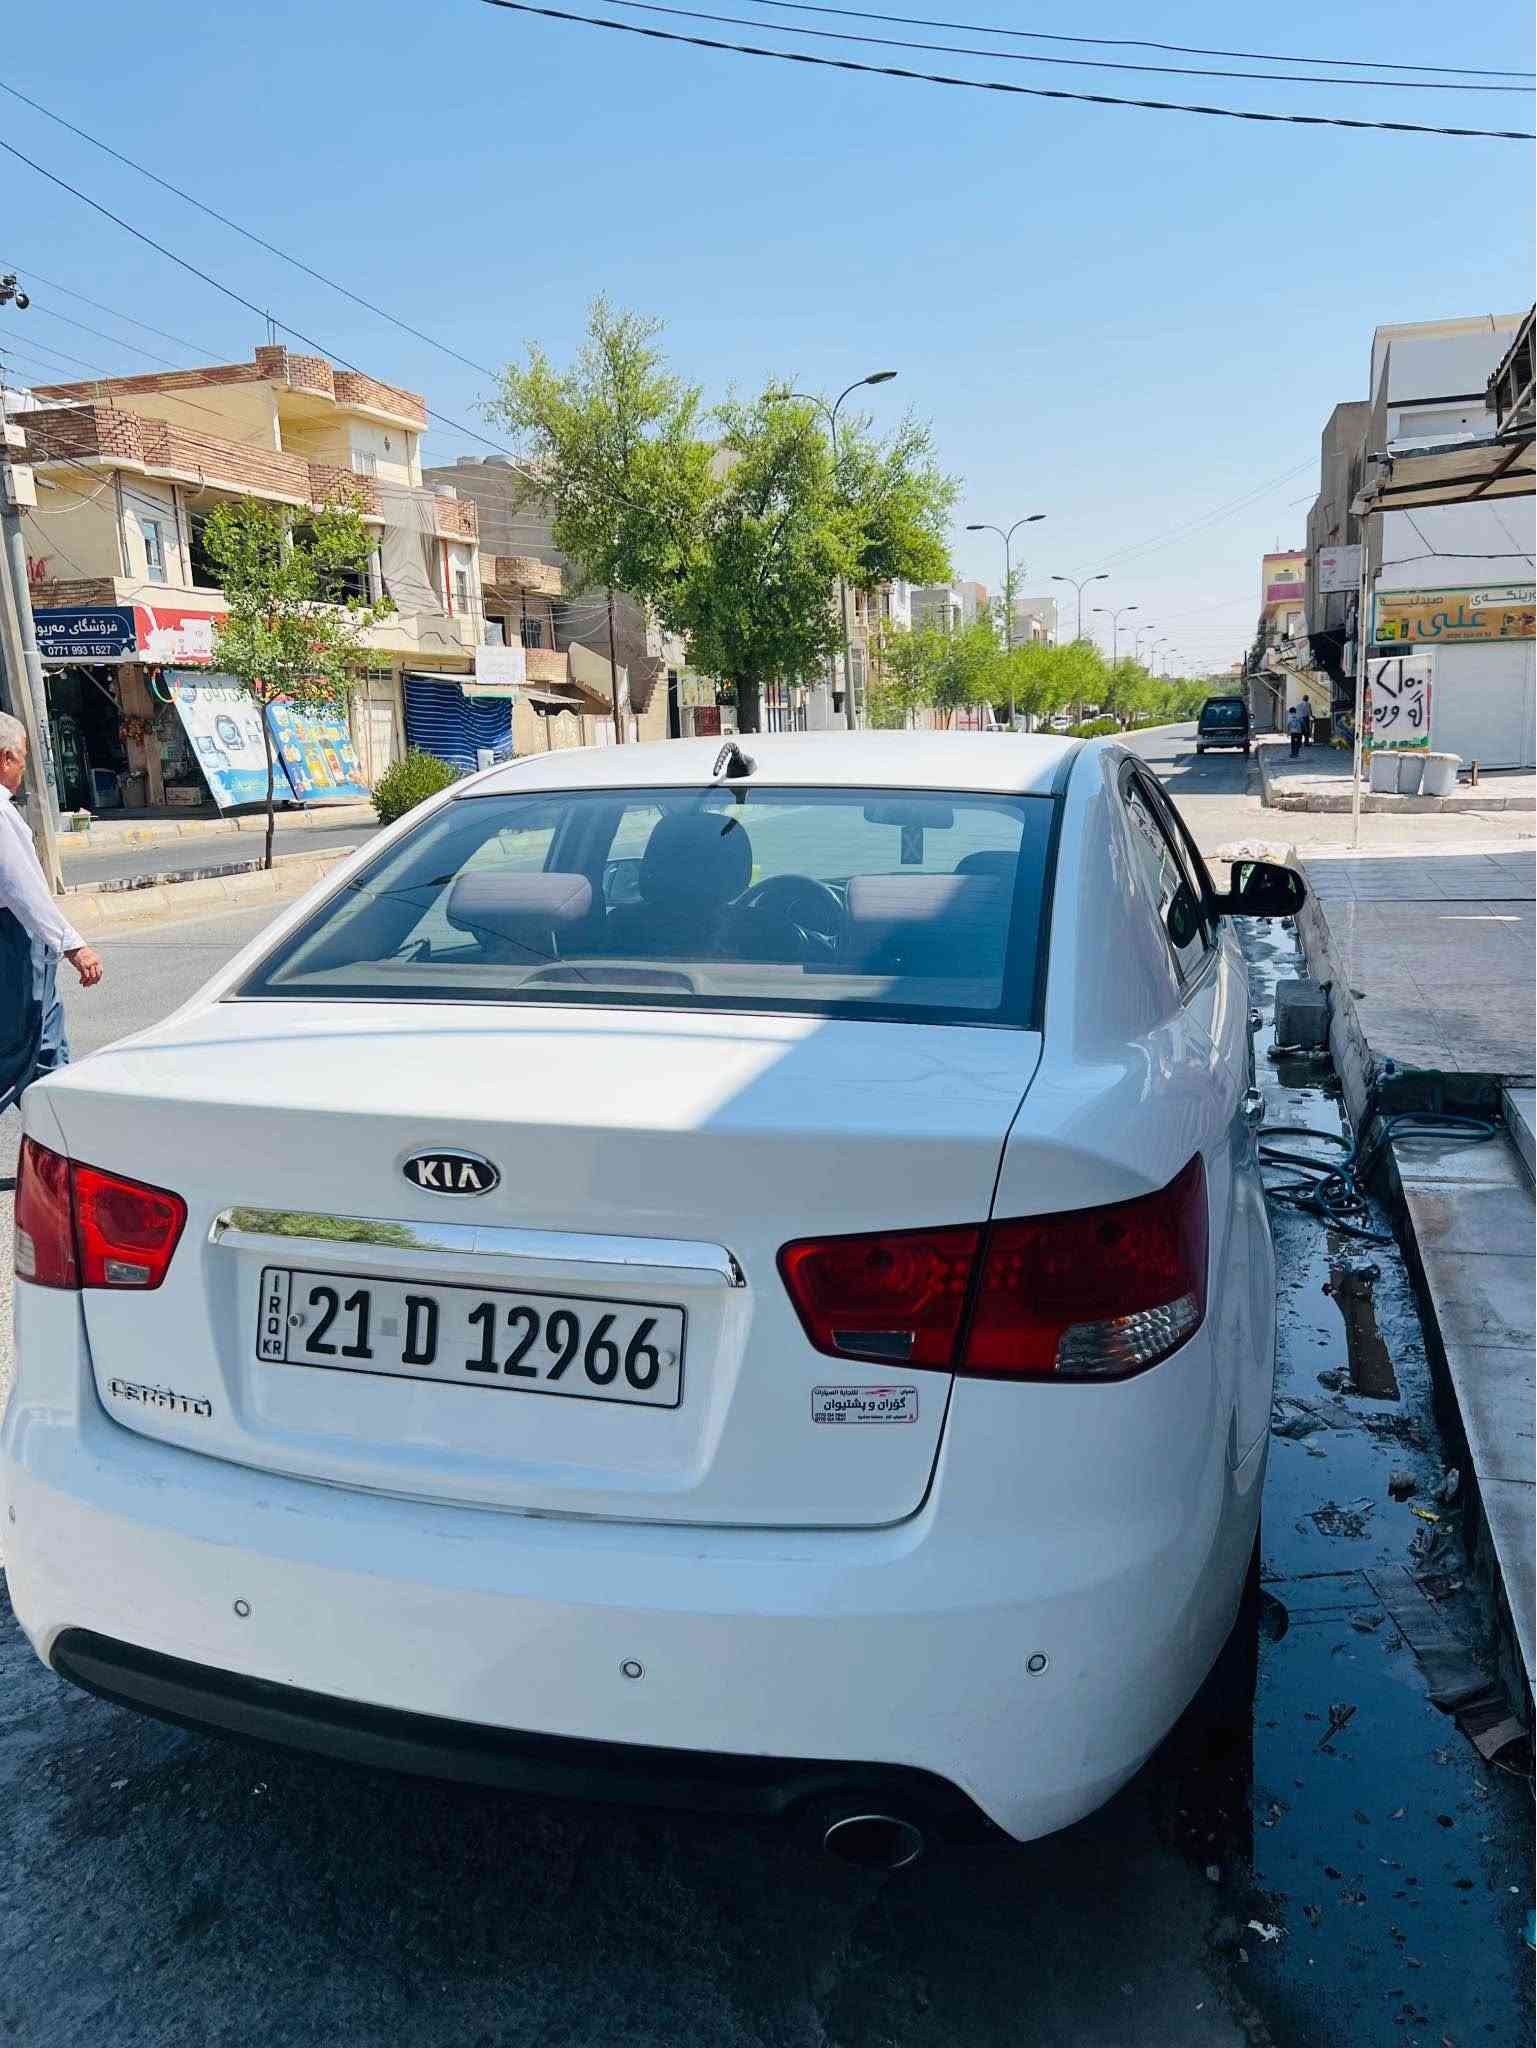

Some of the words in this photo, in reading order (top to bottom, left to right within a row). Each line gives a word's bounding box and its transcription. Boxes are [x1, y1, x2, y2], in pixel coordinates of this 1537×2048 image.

[48, 647, 69, 655] 0771
[416, 1160, 482, 1188] KIA
[305, 1286, 374, 1359] 21
[401, 1295, 439, 1365] D
[465, 1302, 660, 1390] 12966
